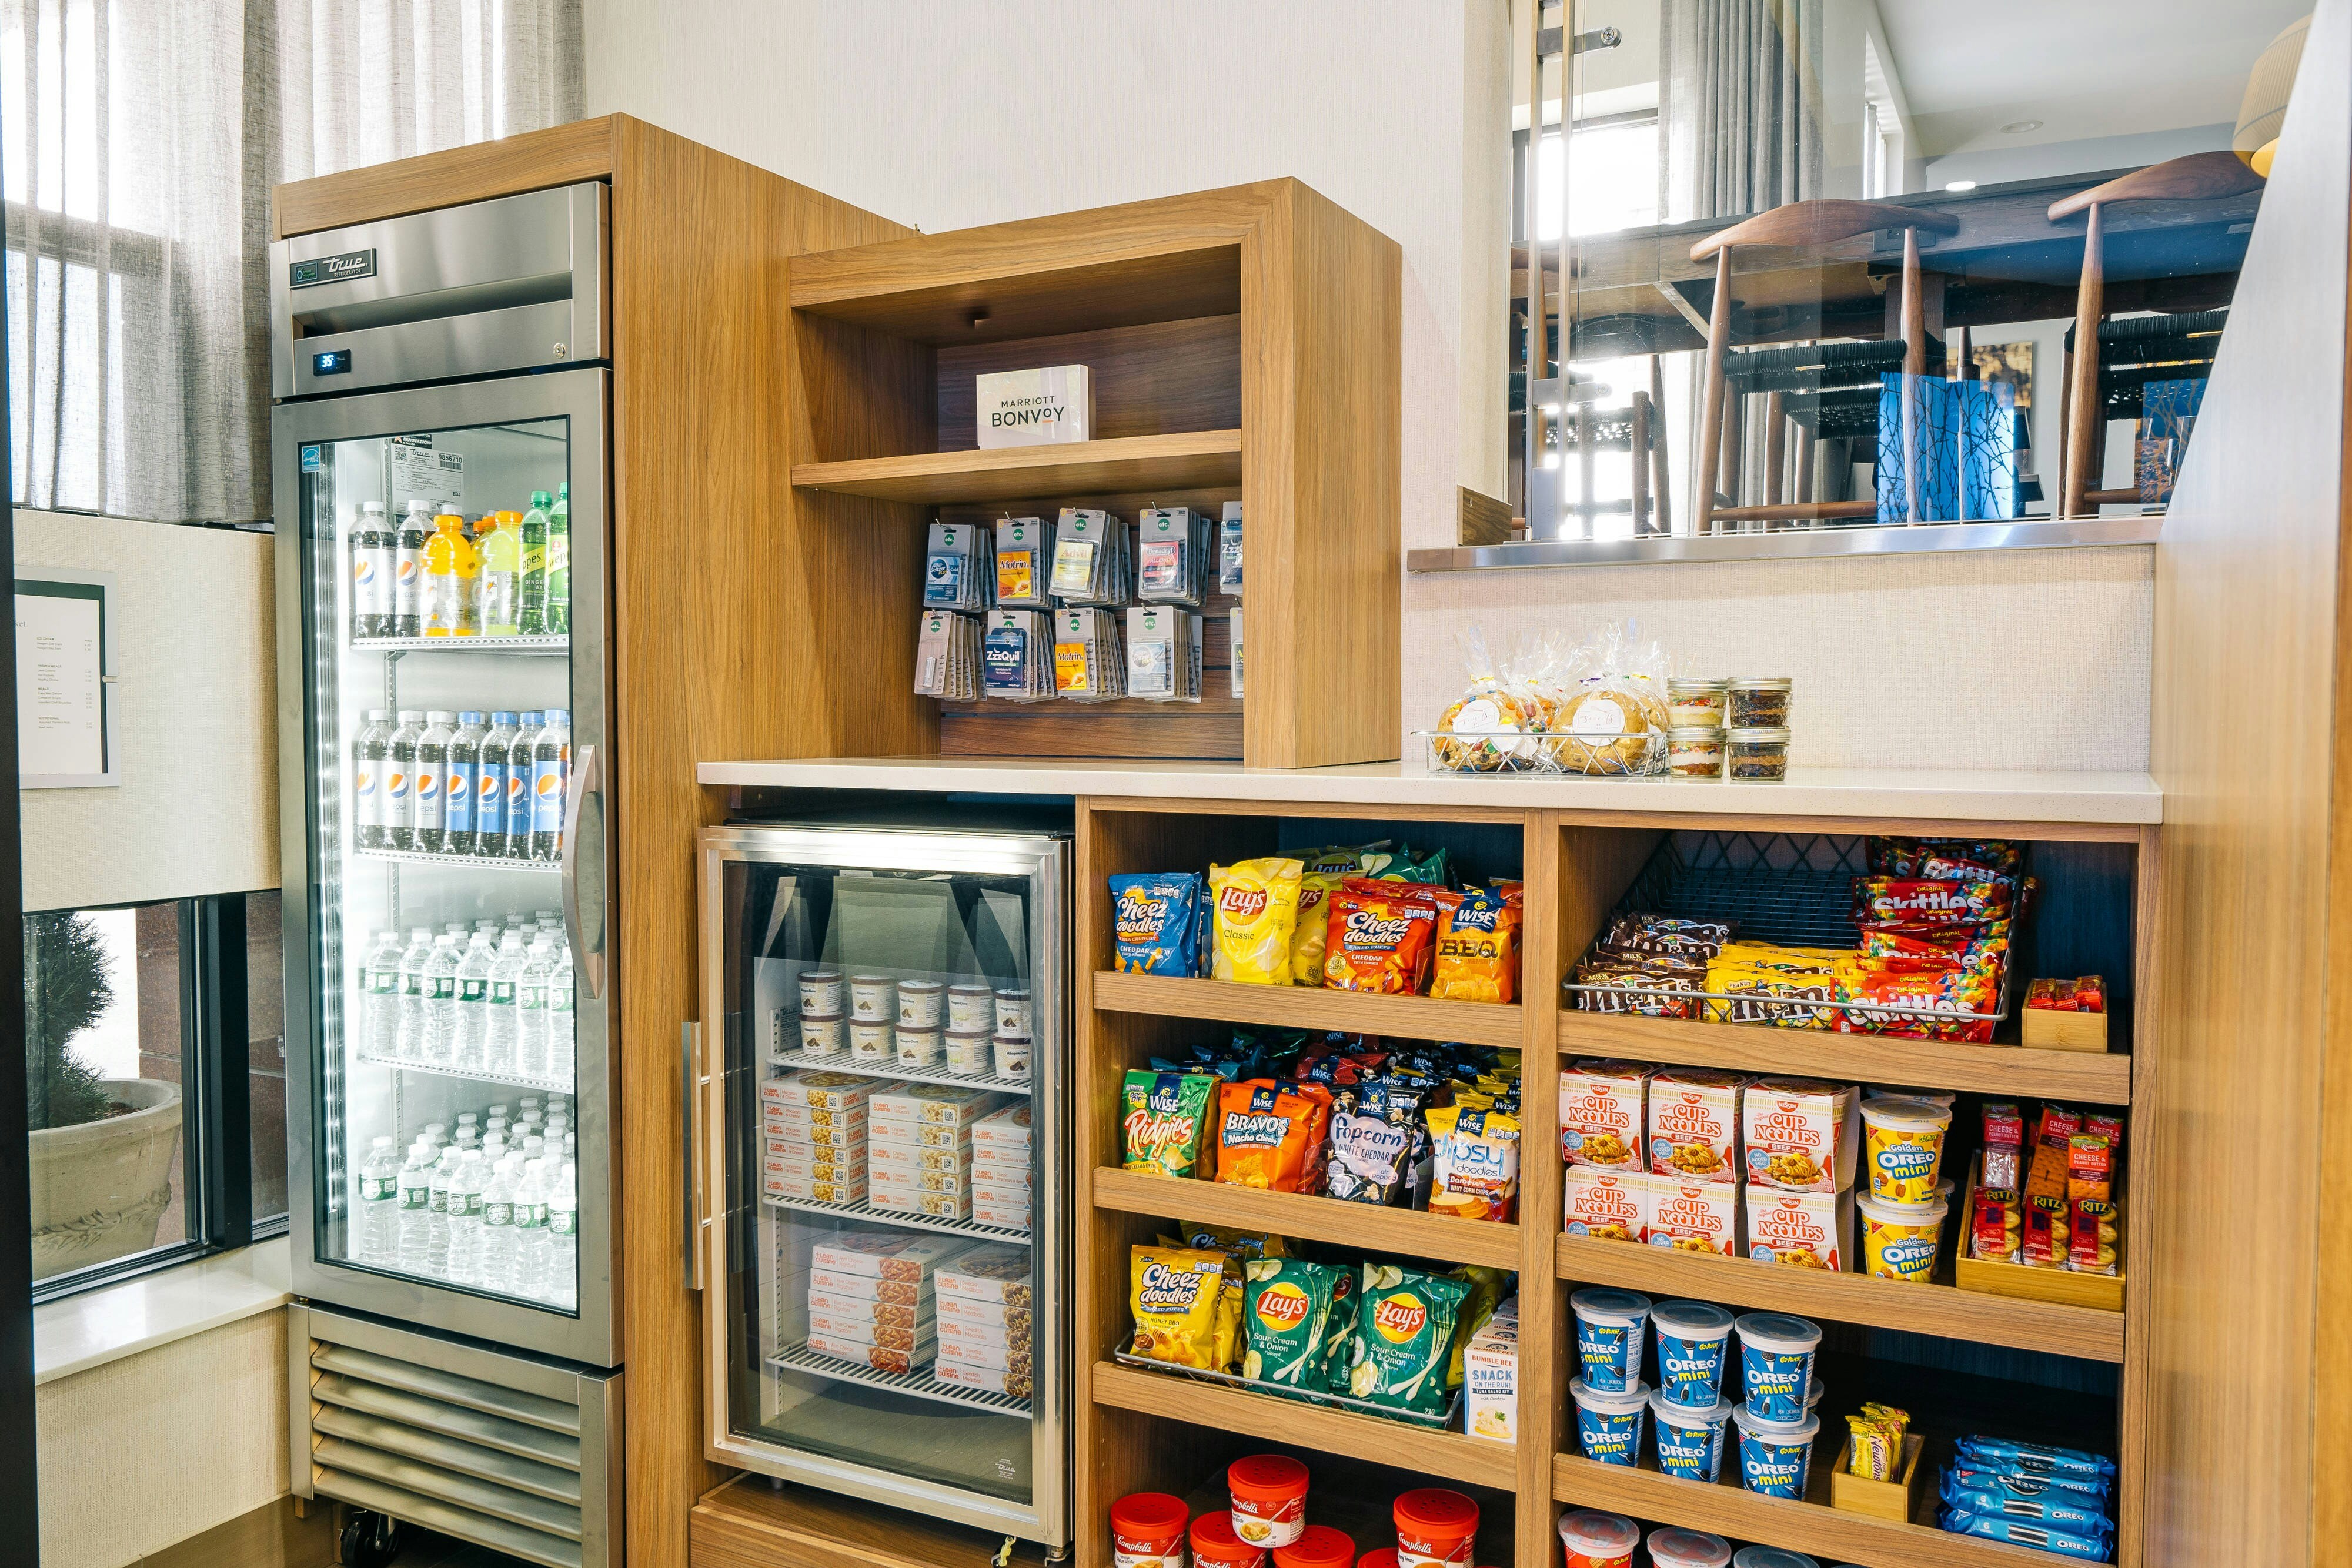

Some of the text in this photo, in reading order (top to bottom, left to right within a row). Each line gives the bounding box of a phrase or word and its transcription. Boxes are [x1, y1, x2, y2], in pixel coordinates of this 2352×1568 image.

[334, 269, 361, 277] REFRIGERATOR
[1001, 396, 1055, 408] MARRIOTT
[992, 407, 1064, 427] BONVOY
[439, 454, 462, 463] 9856710
[1000, 560, 1027, 569] Motrin
[987, 651, 1020, 663] ZzzQuil
[1057, 652, 1081, 660] Motrin
[1222, 887, 1267, 917] Lay's
[1347, 911, 1412, 932] Cheez
[1459, 910, 1494, 924] WISE
[1224, 929, 1255, 940] Classic
[1343, 927, 1406, 944] doodles
[1120, 945, 1150, 954] CHEDDAR
[1439, 938, 1498, 958] BBQ
[1351, 954, 1383, 962] CHEDDAR
[1312, 1069, 1331, 1081] WISE
[1150, 1095, 1179, 1112] WISE
[1254, 1098, 1274, 1108] WISE
[1363, 1101, 1382, 1113] WISE
[1583, 1096, 1617, 1111] CUP
[1569, 1108, 1629, 1127] NOODLES
[1674, 1105, 1709, 1119] CUP
[1225, 1112, 1289, 1136] BRAVOS
[1459, 1118, 1482, 1131] WISE
[1659, 1115, 1722, 1137] NOODLES
[1769, 1114, 1807, 1129] CUP
[1125, 1109, 1194, 1160] Ridgies
[1336, 1116, 1403, 1147] Popcorn
[1755, 1125, 1820, 1146] NOODLES
[1989, 1125, 2013, 1133] CHEESE
[1228, 1134, 1277, 1144] Nacho Cheese
[1338, 1144, 1389, 1162] WHITE CHEDDAR
[1435, 1134, 1505, 1177] dipsy
[1879, 1152, 1935, 1166] OREO
[1372, 1173, 1396, 1182] popped
[1456, 1165, 1498, 1177] doodles
[1894, 1165, 1929, 1177] mini
[1451, 1176, 1485, 1187] Barbecue
[1450, 1185, 1462, 1193] WAVY
[1463, 1186, 1475, 1195] CORN
[1986, 1190, 2013, 1202] RITZ
[2033, 1197, 2062, 1208] RITZ
[1142, 1263, 1204, 1290] Cheez
[1140, 1286, 1198, 1305] doodles
[1259, 1292, 1307, 1320] Lay's
[1378, 1302, 1424, 1333] Lay's
[1254, 1332, 1298, 1346] Sour Cream
[1266, 1342, 1289, 1352] Onion
[1371, 1343, 1415, 1360] Sour Cream
[1384, 1355, 1406, 1366] Onion
[1472, 1355, 1513, 1367] BUMBLE BEE
[1666, 1358, 1716, 1372] OREO
[1472, 1370, 1512, 1381] SNACK
[1678, 1369, 1711, 1382] mini
[1748, 1370, 1799, 1384] OREO
[1759, 1383, 1793, 1395] mini
[1424, 1407, 1435, 1416] 230
[1997, 1475, 2049, 1492] OREO
[2051, 1510, 2084, 1522] OREO
[1117, 1536, 1152, 1553] Campbell's
[1399, 1531, 1432, 1554] Campbell's
[2057, 1540, 2089, 1552] OREO
